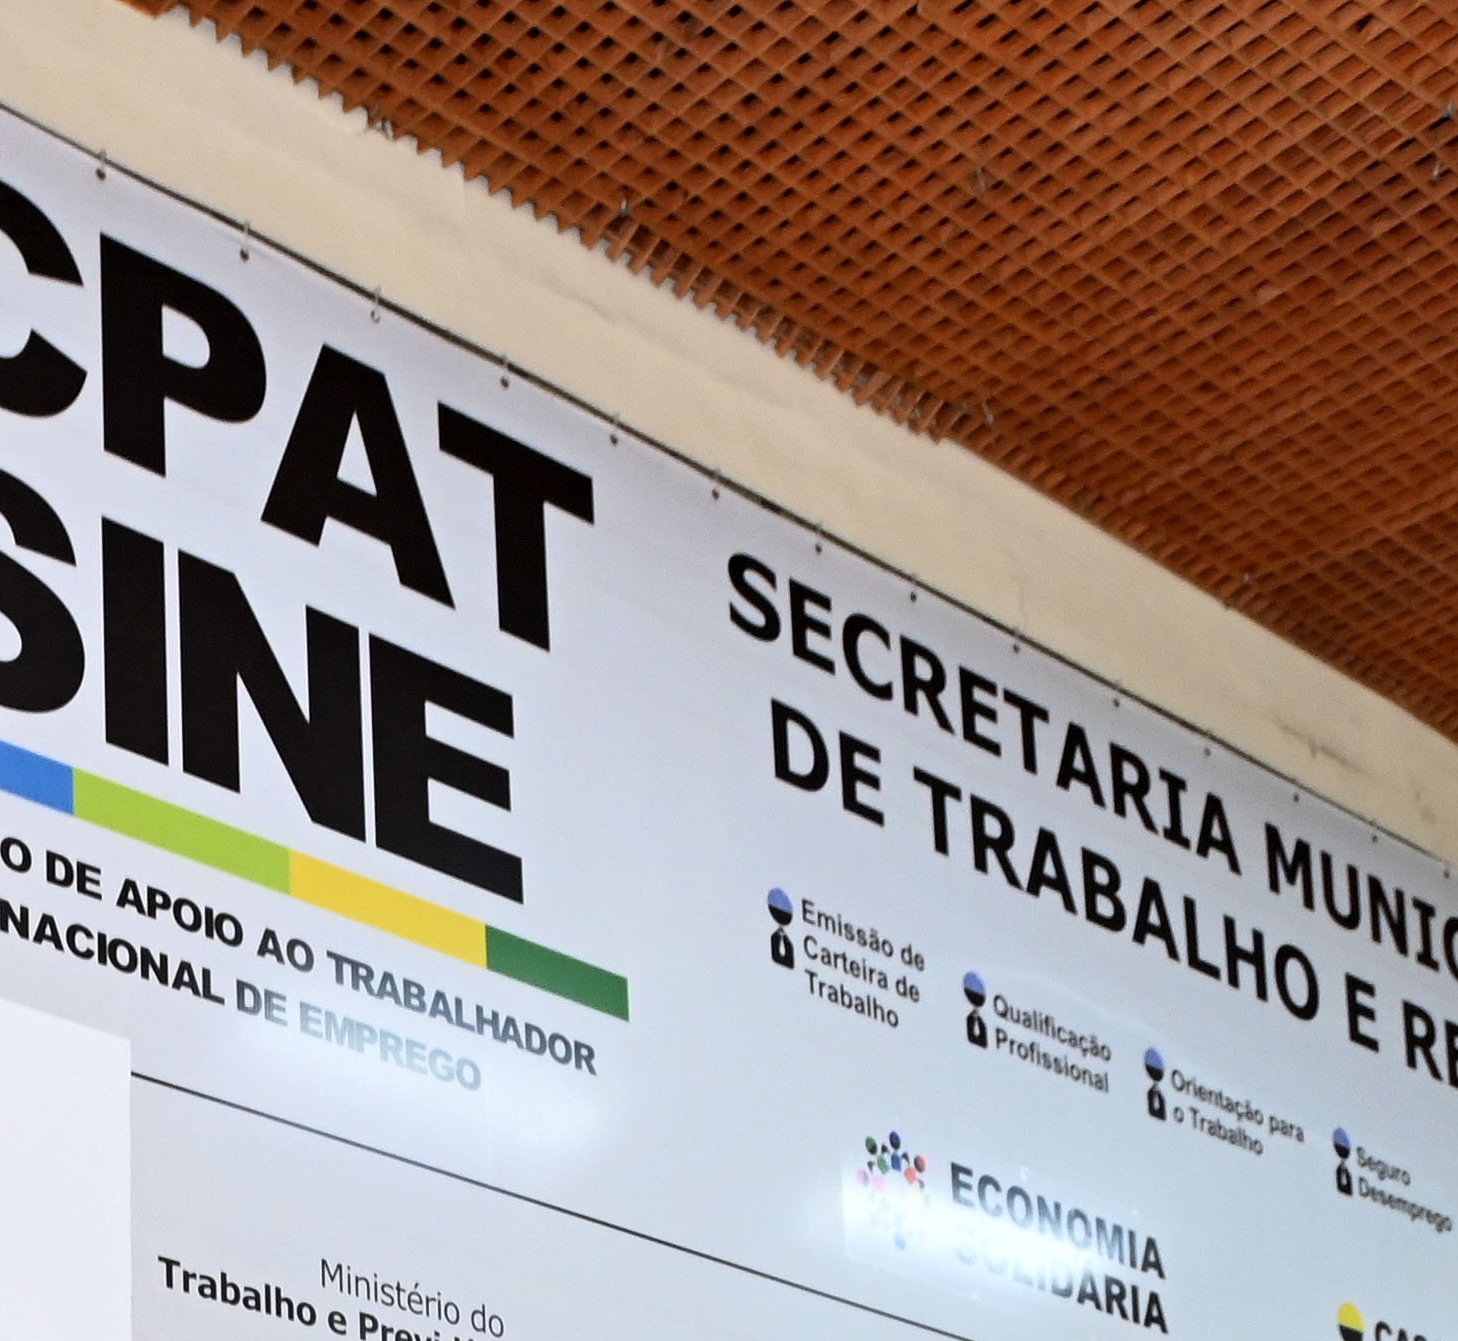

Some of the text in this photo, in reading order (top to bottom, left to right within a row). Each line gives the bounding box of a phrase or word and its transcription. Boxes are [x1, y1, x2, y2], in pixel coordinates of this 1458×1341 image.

[726, 552, 1241, 876] SECRETARIA
[770, 697, 886, 828] DE
[913, 766, 1321, 1022] TRABALHO
[1345, 972, 1380, 1053] E
[46, 848, 103, 899] DE
[115, 876, 244, 949] APOIO
[256, 921, 316, 974] AO
[327, 949, 598, 1076] TRABALHADOR
[801, 897, 926, 972] Emissão de
[803, 935, 921, 1002] Carteira de
[235, 978, 289, 1027] DE
[299, 1001, 483, 1092] EMPREGO
[805, 969, 899, 1029] Trabalho
[993, 993, 1112, 1063] Qualificação
[995, 1027, 1110, 1094] Profissional
[1171, 1068, 1305, 1144] Orientação para
[1173, 1105, 1264, 1156] o Trabalho
[1356, 1146, 1412, 1187] Seguro
[950, 1161, 1166, 1281] ECONOMIA
[1358, 1176, 1453, 1234] Desemprego
[157, 1255, 317, 1327] Trabalho
[327, 1309, 348, 1335] e
[320, 1257, 505, 1338] Ministério do
